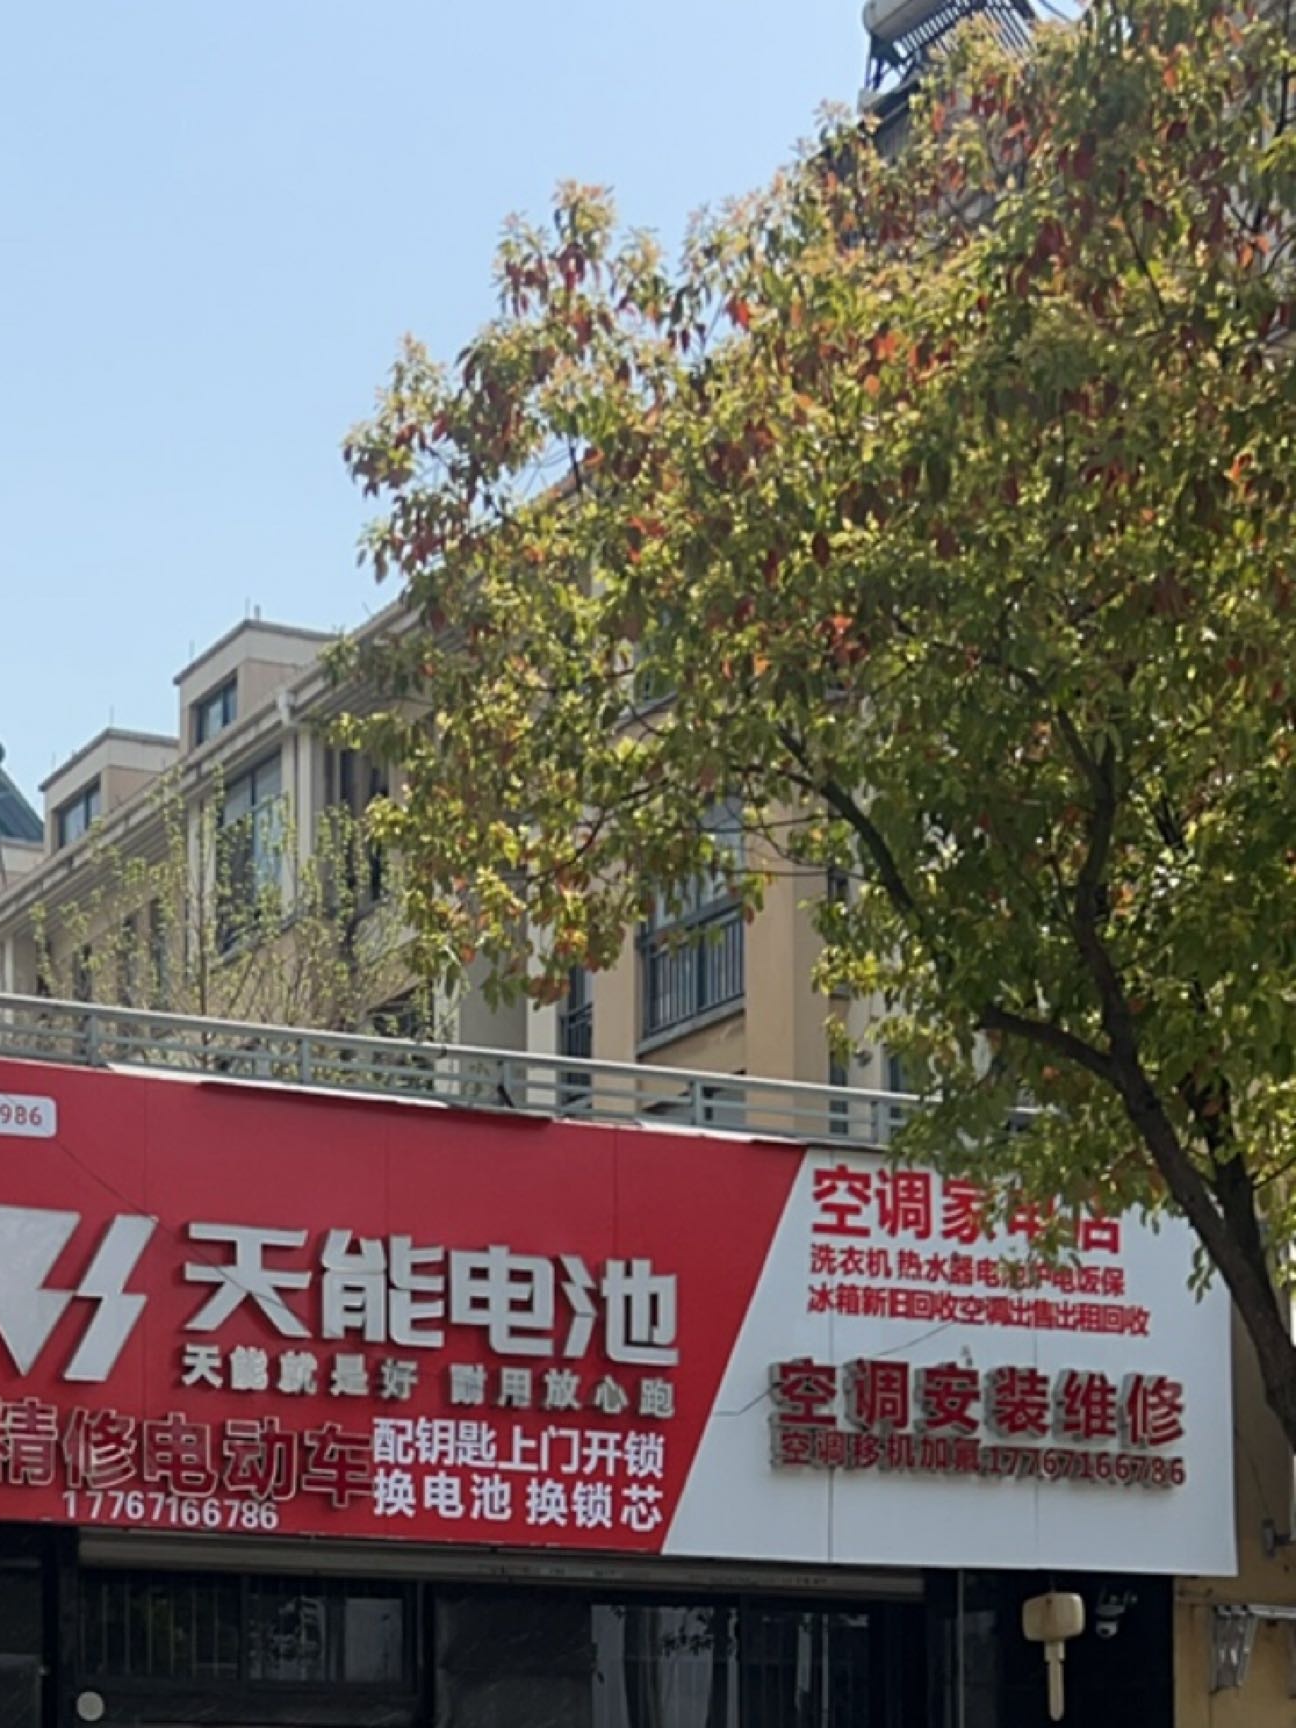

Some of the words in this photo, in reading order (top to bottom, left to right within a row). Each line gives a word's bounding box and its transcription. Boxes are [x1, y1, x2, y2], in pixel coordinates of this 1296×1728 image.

[183, 1221, 680, 1366] 天能电池
[181, 1343, 421, 1402] 天能就是好
[449, 1361, 675, 1421] 耐用放心跑
[770, 1356, 1186, 1448] 空调安装维修
[371, 1416, 665, 1480] 配钥匙上门开锁
[62, 1489, 280, 1530] 17767166786
[371, 1470, 513, 1522] 换电池
[526, 1482, 665, 1533] 换锁芯
